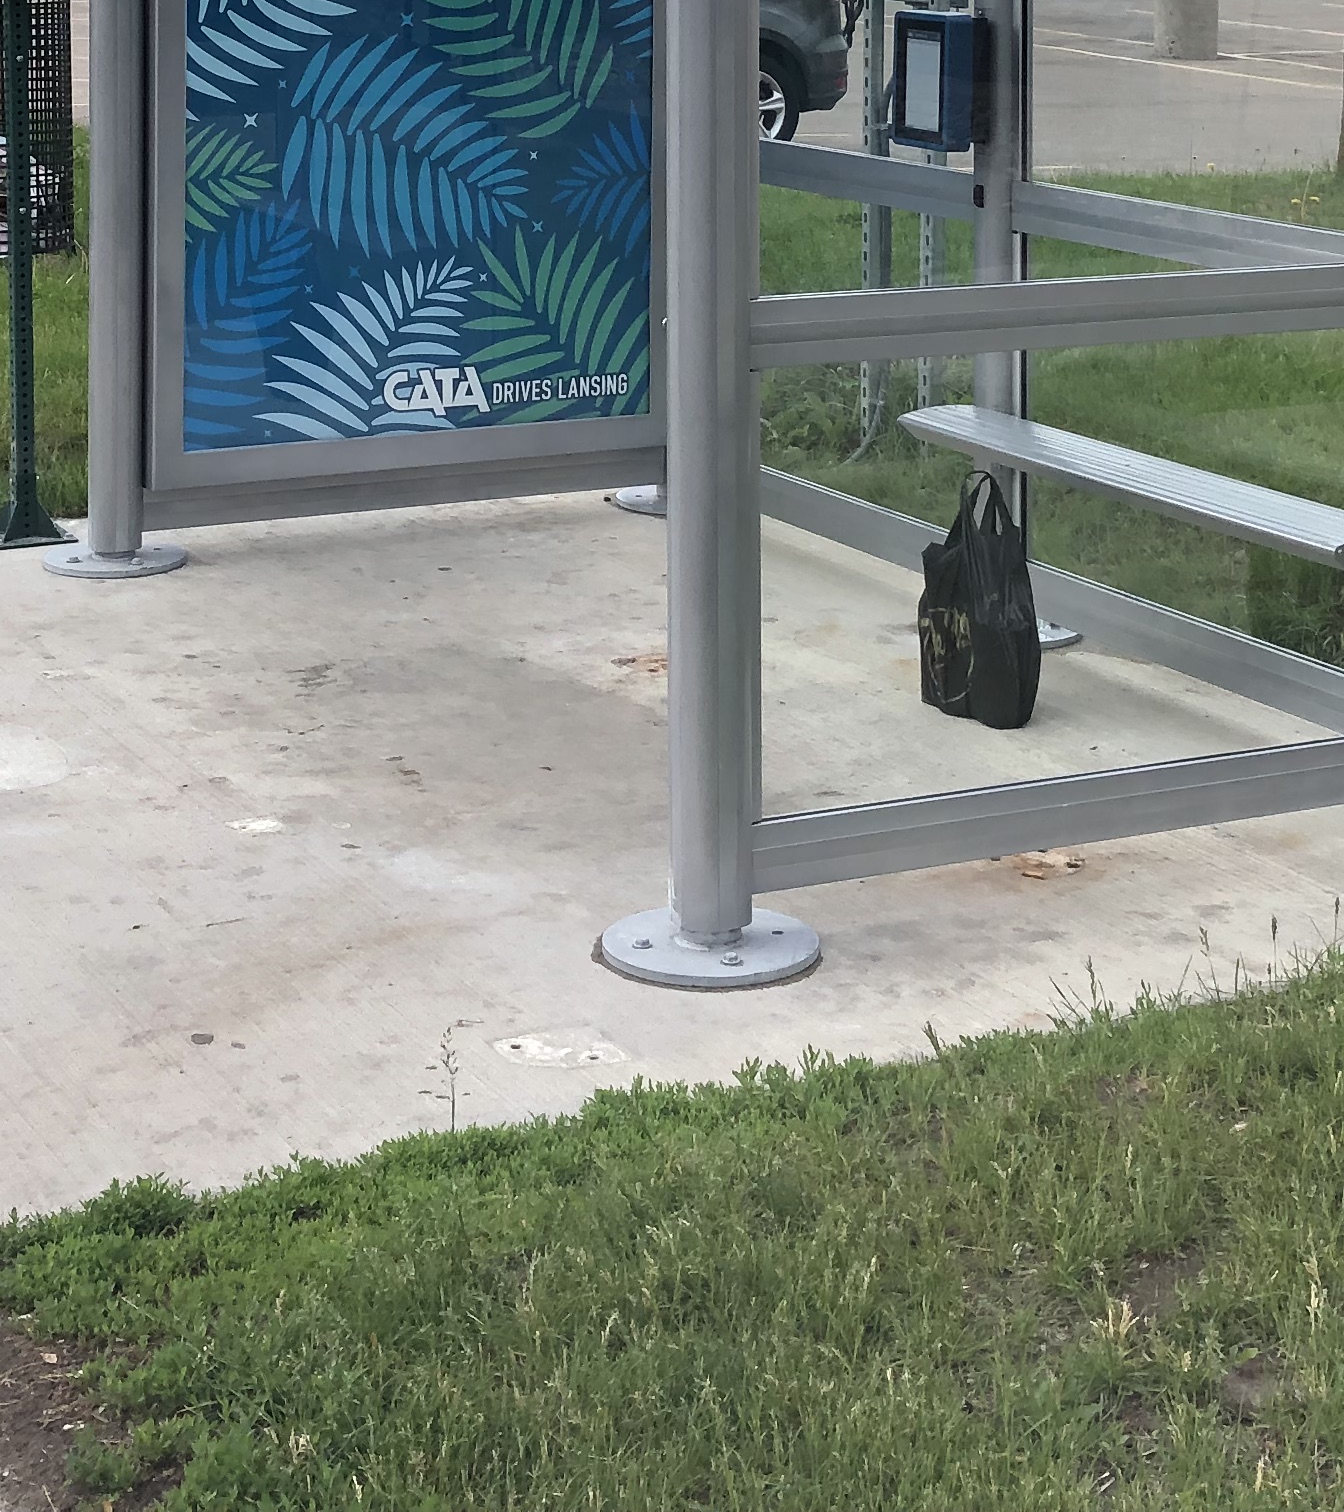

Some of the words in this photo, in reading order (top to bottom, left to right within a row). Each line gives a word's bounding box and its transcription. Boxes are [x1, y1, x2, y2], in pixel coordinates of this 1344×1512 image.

[383, 366, 491, 417] CATA
[492, 379, 552, 405] DRIVES
[558, 374, 628, 400] LANSING
